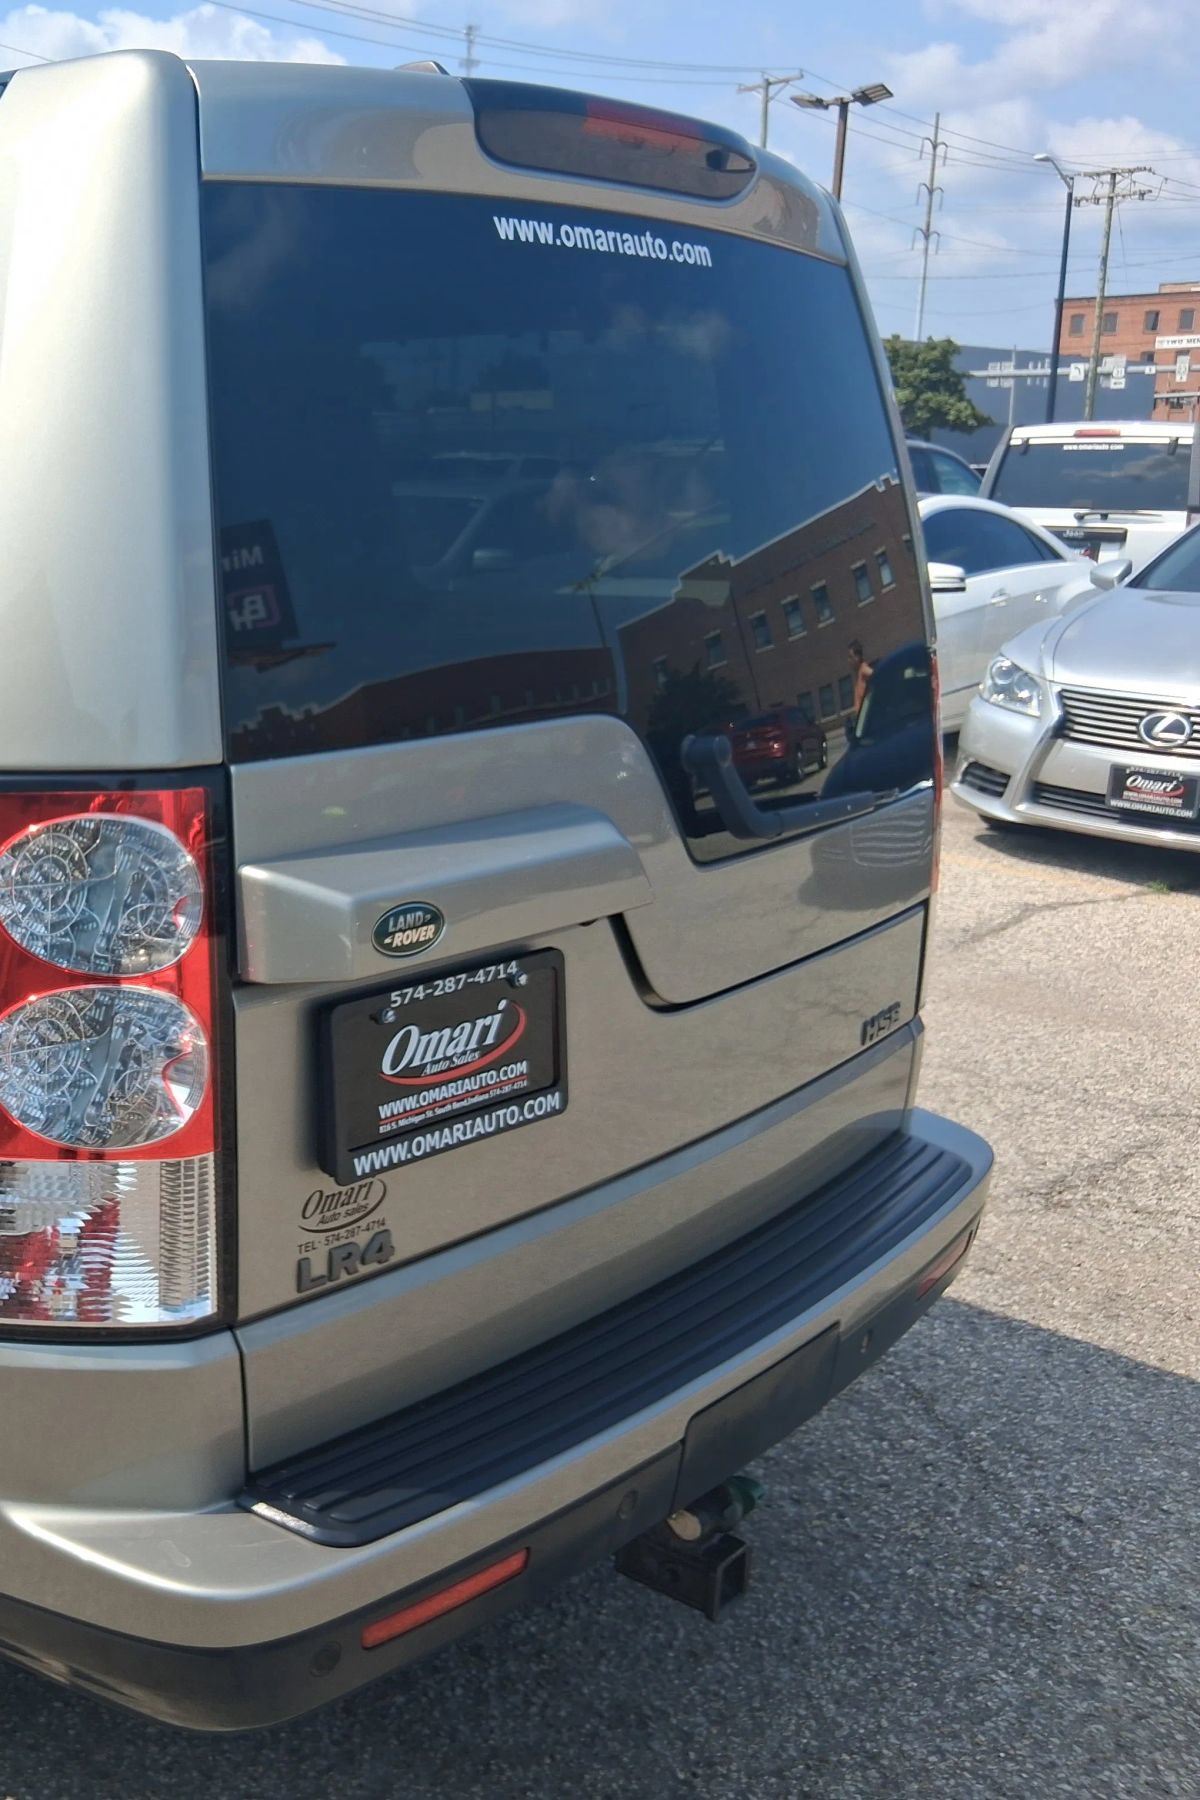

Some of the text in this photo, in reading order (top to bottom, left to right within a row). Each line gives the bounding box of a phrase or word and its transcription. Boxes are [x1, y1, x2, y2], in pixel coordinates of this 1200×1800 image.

[493, 215, 713, 267] www.omariauto.com
[1110, 799, 1193, 818] WWW.OMARIAUTO.COM
[388, 911, 424, 933] LAND
[392, 923, 436, 948] ROVER
[390, 960, 518, 1008] 574-287-4714
[381, 999, 508, 1076] Omari
[421, 1050, 481, 1076] Auto Sales
[379, 1060, 528, 1119] WWW.OMARIAUTO.COM
[353, 1091, 561, 1177] WWW.OMARIAUTO.COM
[302, 1180, 375, 1220] Omari
[316, 1211, 341, 1227] Auto
[297, 1229, 396, 1294] LR4
